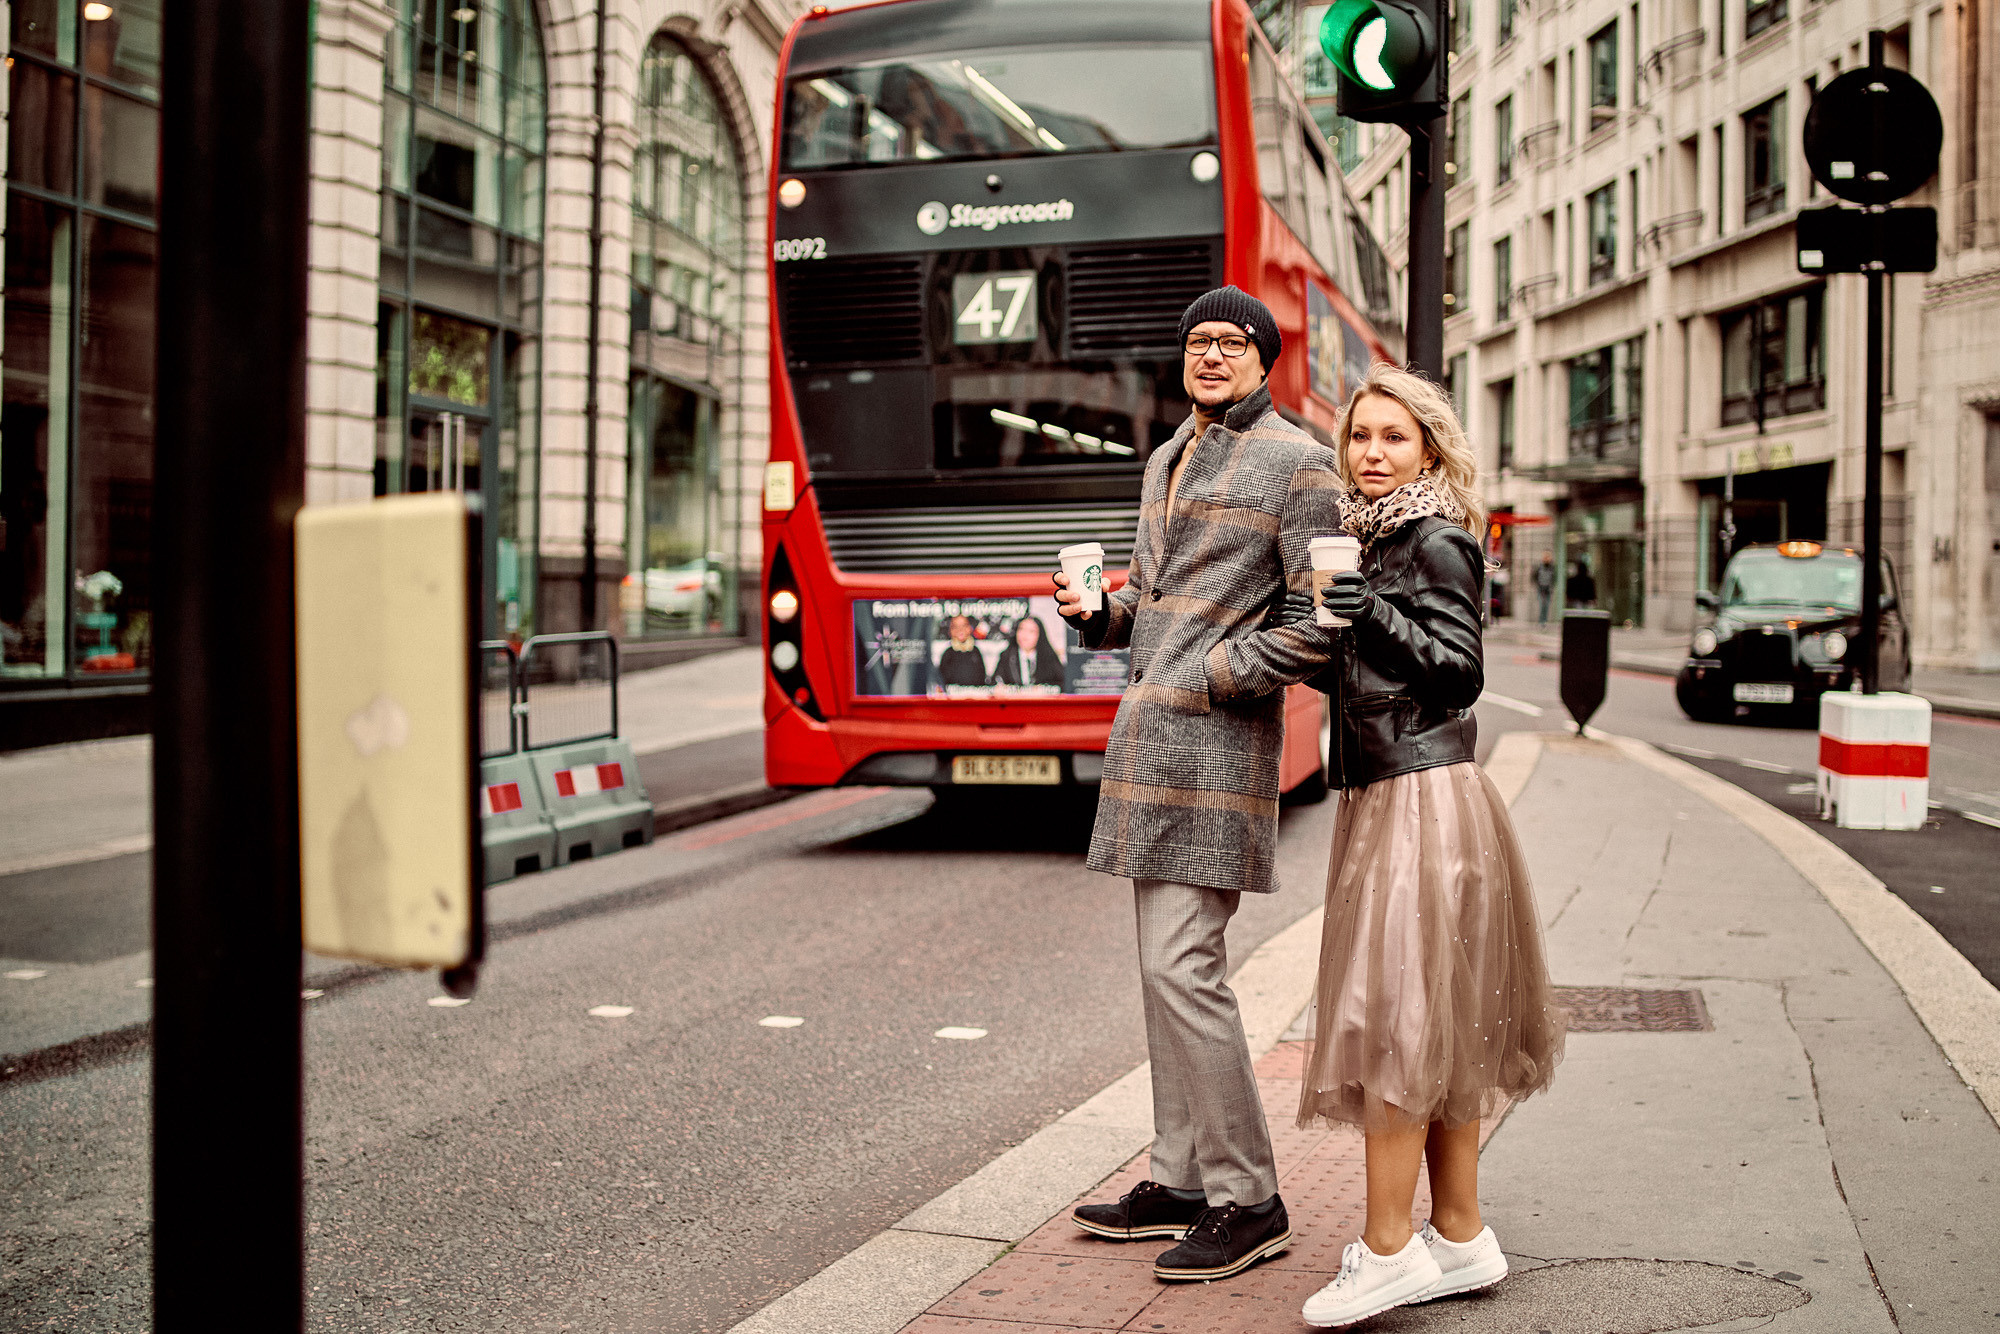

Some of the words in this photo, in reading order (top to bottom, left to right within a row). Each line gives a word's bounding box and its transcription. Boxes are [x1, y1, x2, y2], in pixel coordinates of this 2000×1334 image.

[949, 198, 1074, 231] Stagecoach
[957, 276, 1033, 338] 47
[909, 600, 943, 618] here
[944, 600, 960, 617] to
[961, 599, 1028, 620] university
